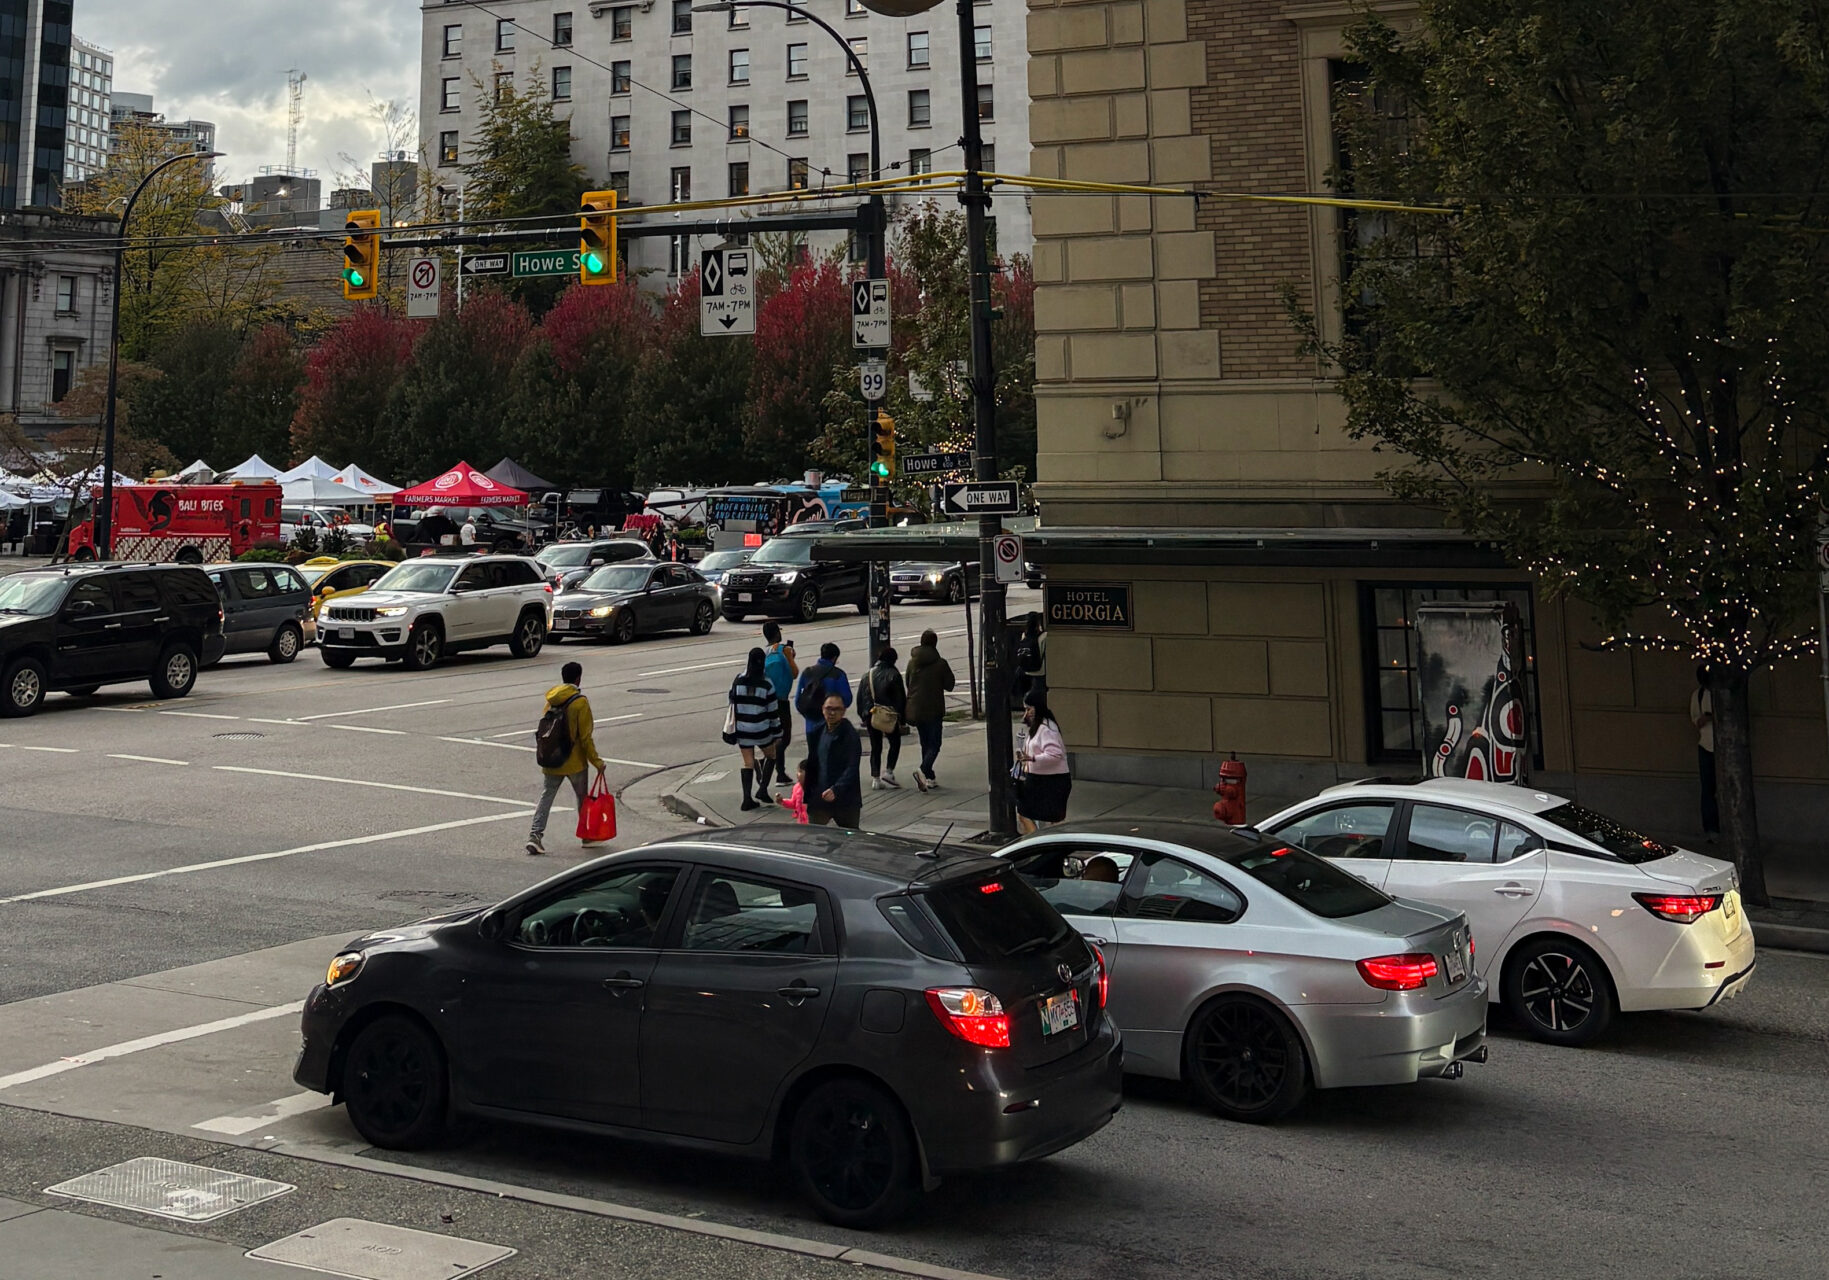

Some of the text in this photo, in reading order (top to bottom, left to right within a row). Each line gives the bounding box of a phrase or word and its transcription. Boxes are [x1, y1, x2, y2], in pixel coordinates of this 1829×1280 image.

[474, 258, 504, 269] ONE WAY
[519, 253, 581, 273] Howe S
[863, 373, 883, 391] 99
[906, 457, 938, 471] Howe
[404, 495, 459, 505] FARMERS MARKET
[966, 491, 1010, 504] ONE WAY
[178, 499, 224, 512] BALI BITES
[715, 502, 769, 512] ORDER ONLINE
[714, 511, 731, 520] AND
[1067, 591, 1109, 602] HOTEL
[1051, 604, 1125, 621] GEORGIA
